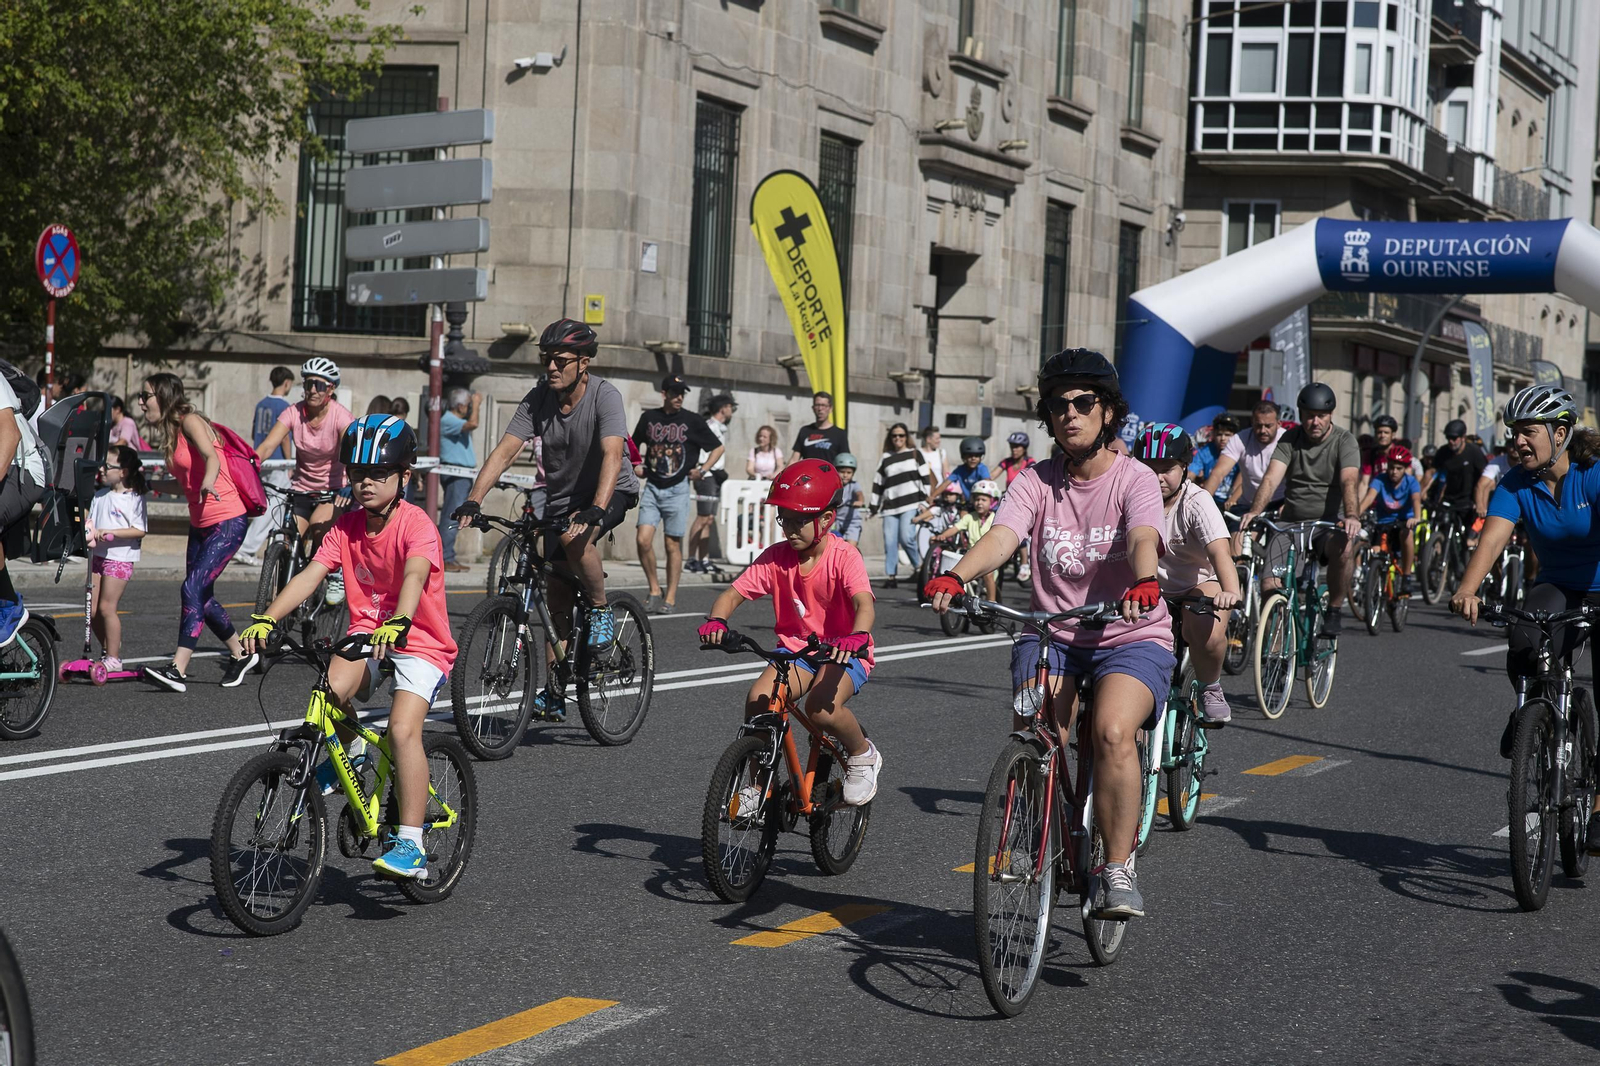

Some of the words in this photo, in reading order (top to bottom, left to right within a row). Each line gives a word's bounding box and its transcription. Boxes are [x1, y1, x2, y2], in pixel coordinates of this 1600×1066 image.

[1384, 233, 1532, 256] DEPUTACIÓN
[1382, 259, 1491, 278] OURENSE
[787, 246, 832, 343] DEPORTE
[1043, 526, 1071, 540] Día
[338, 751, 373, 820] ROCKRIDER
